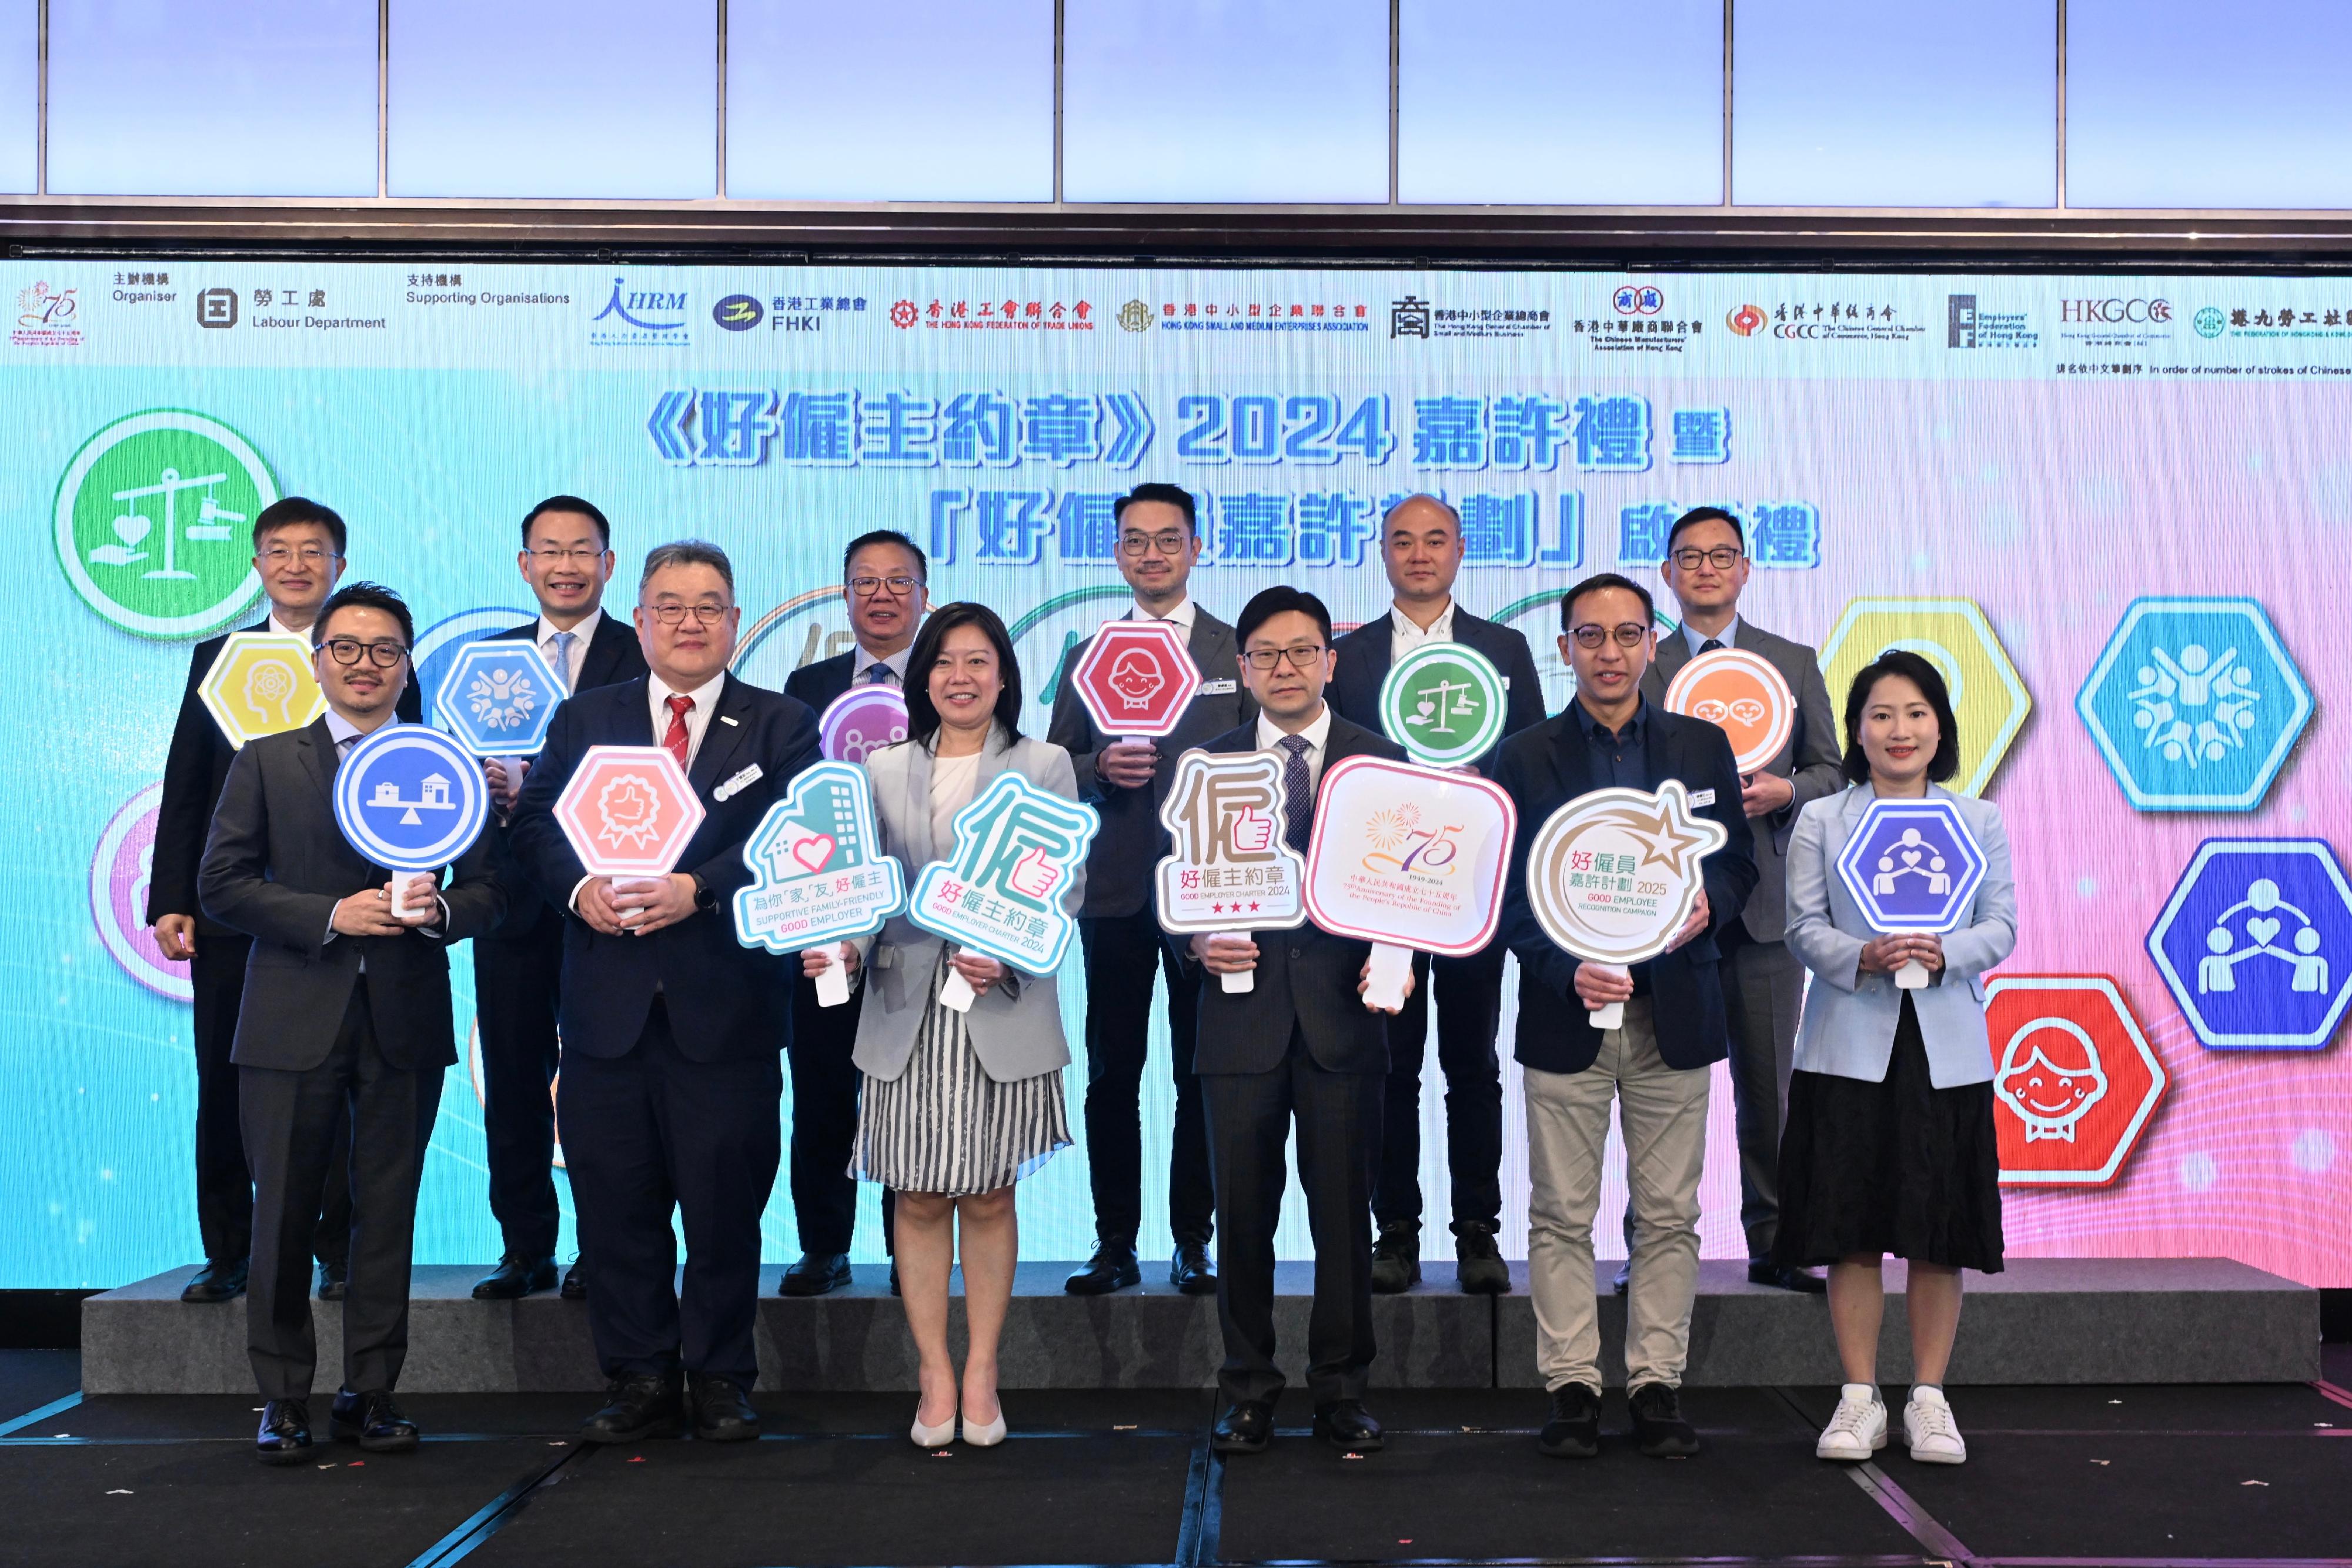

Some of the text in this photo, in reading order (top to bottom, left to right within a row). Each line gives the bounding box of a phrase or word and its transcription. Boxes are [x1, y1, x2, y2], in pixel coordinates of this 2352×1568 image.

[407, 274, 463, 287] 支持機構
[113, 290, 177, 304] Organiser
[253, 289, 326, 307] 勞工處
[406, 292, 570, 306] Supporting Organisations
[772, 296, 867, 311] 香港工業總會
[43, 287, 77, 323] 75
[1162, 303, 1367, 317] 香港中小型企業聯合會
[2060, 298, 2172, 323] HKGCC
[253, 316, 386, 330] Labour Department
[773, 316, 820, 331] FHKI
[926, 320, 938, 329] THE
[987, 321, 1028, 329] FEDERATION
[1043, 322, 1065, 330] TRADE
[1162, 321, 1369, 331] HONG KONG SMALL AND MEDIUM ENTERPRISES ASSOCIATION
[1773, 324, 1819, 339] CGCC
[1990, 332, 2013, 340] Hong
[2015, 332, 2039, 340] Kong
[2150, 365, 2351, 375] In order of number of strokes of Chinese
[1177, 397, 1388, 460] 2024
[1401, 824, 1464, 872] 75
[1571, 850, 1636, 876] 好僱員
[1180, 865, 1285, 889] 好僱主約章
[1408, 874, 1444, 886] 1949-2024
[1569, 872, 1668, 896] 嘉許計劃 2025
[1200, 891, 1234, 899] EMPLOYER
[1236, 890, 1265, 898] CHARTER
[1267, 885, 1290, 896] 2024
[1355, 885, 1396, 900] Anniversary
[1419, 897, 1452, 911] Founding
[1453, 904, 1461, 912] of
[1349, 892, 1361, 900] the
[1392, 900, 1421, 911] Republic
[1432, 908, 1452, 917] China
[1588, 892, 1658, 908] GOOD EMPLOYEE
[756, 890, 885, 927] SUPPORTIVE FAMILY-FRIENDLY
[937, 880, 1049, 940] 好僱主約章
[1578, 902, 1657, 917] RECOGNITION CAMPAIGN
[780, 907, 863, 934] GOOD EMPLOYER
[933, 901, 1045, 954] GOOD EMPLOYER CHARTER 2024
